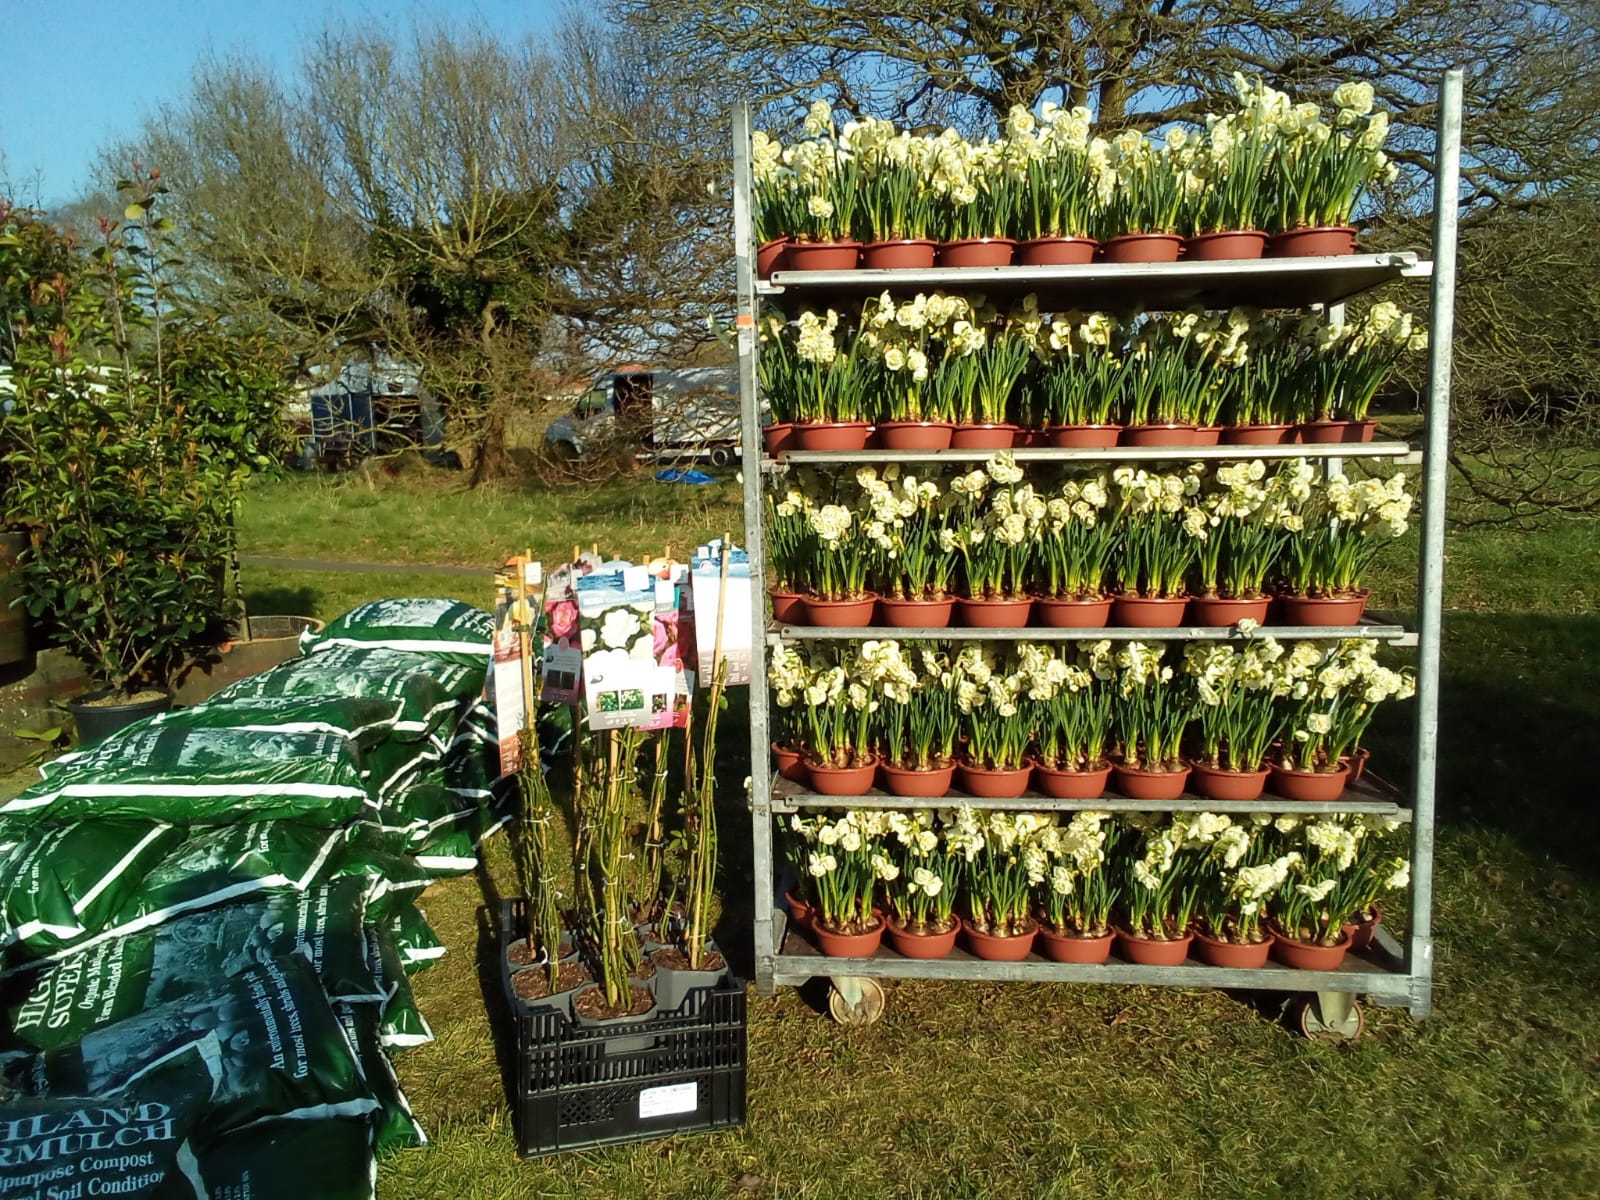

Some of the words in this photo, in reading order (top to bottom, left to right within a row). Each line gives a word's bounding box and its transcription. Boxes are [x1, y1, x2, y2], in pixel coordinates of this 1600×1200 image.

[289, 1034, 306, 1057] most
[270, 1053, 285, 1069] An
[293, 1060, 308, 1078] for
[80, 1151, 155, 1172] Compost
[47, 1181, 82, 1200] Soil
